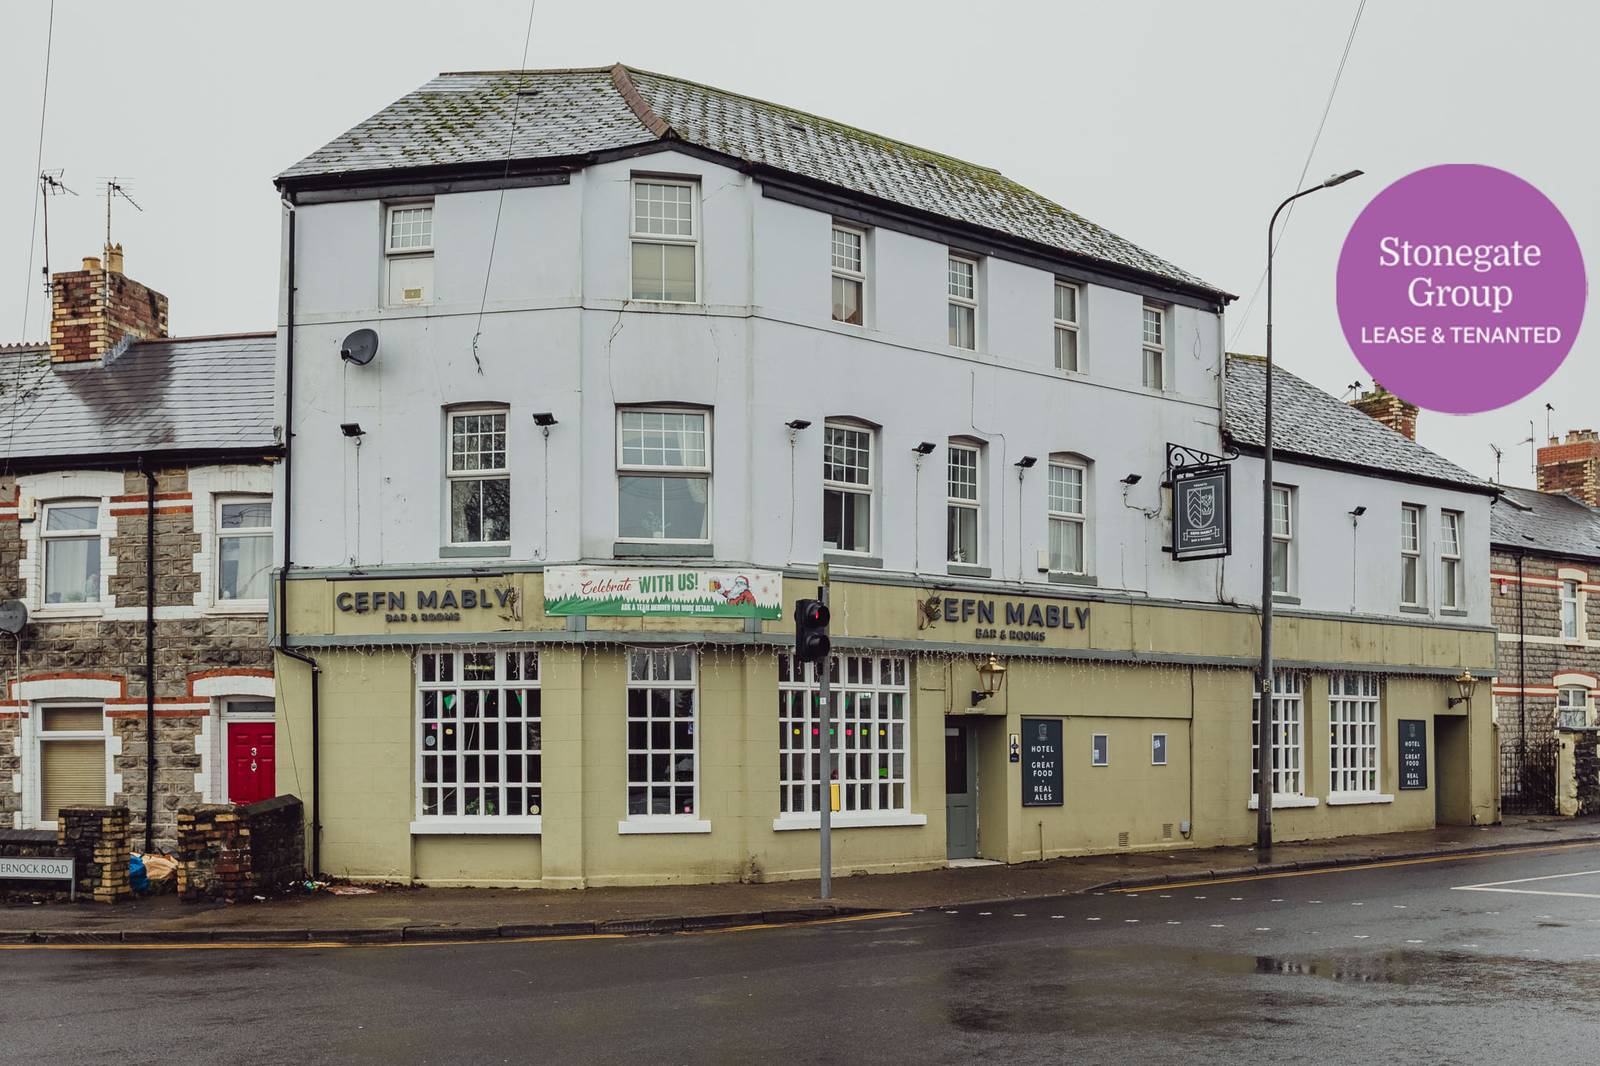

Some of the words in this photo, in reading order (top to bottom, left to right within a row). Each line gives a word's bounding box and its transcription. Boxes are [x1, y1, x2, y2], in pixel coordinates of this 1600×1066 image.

[581, 577, 636, 595] Celebrate
[639, 574, 674, 594] WITH
[678, 572, 698, 592] US!
[336, 591, 405, 613] CEFN
[417, 588, 511, 610] MABLY
[1005, 602, 1091, 629] MABLY
[975, 628, 997, 639] BAR
[1000, 629, 1007, 640] &
[1009, 629, 1046, 641] ROOMS
[251, 747, 257, 756] 3
[40, 864, 69, 875] ROAD
